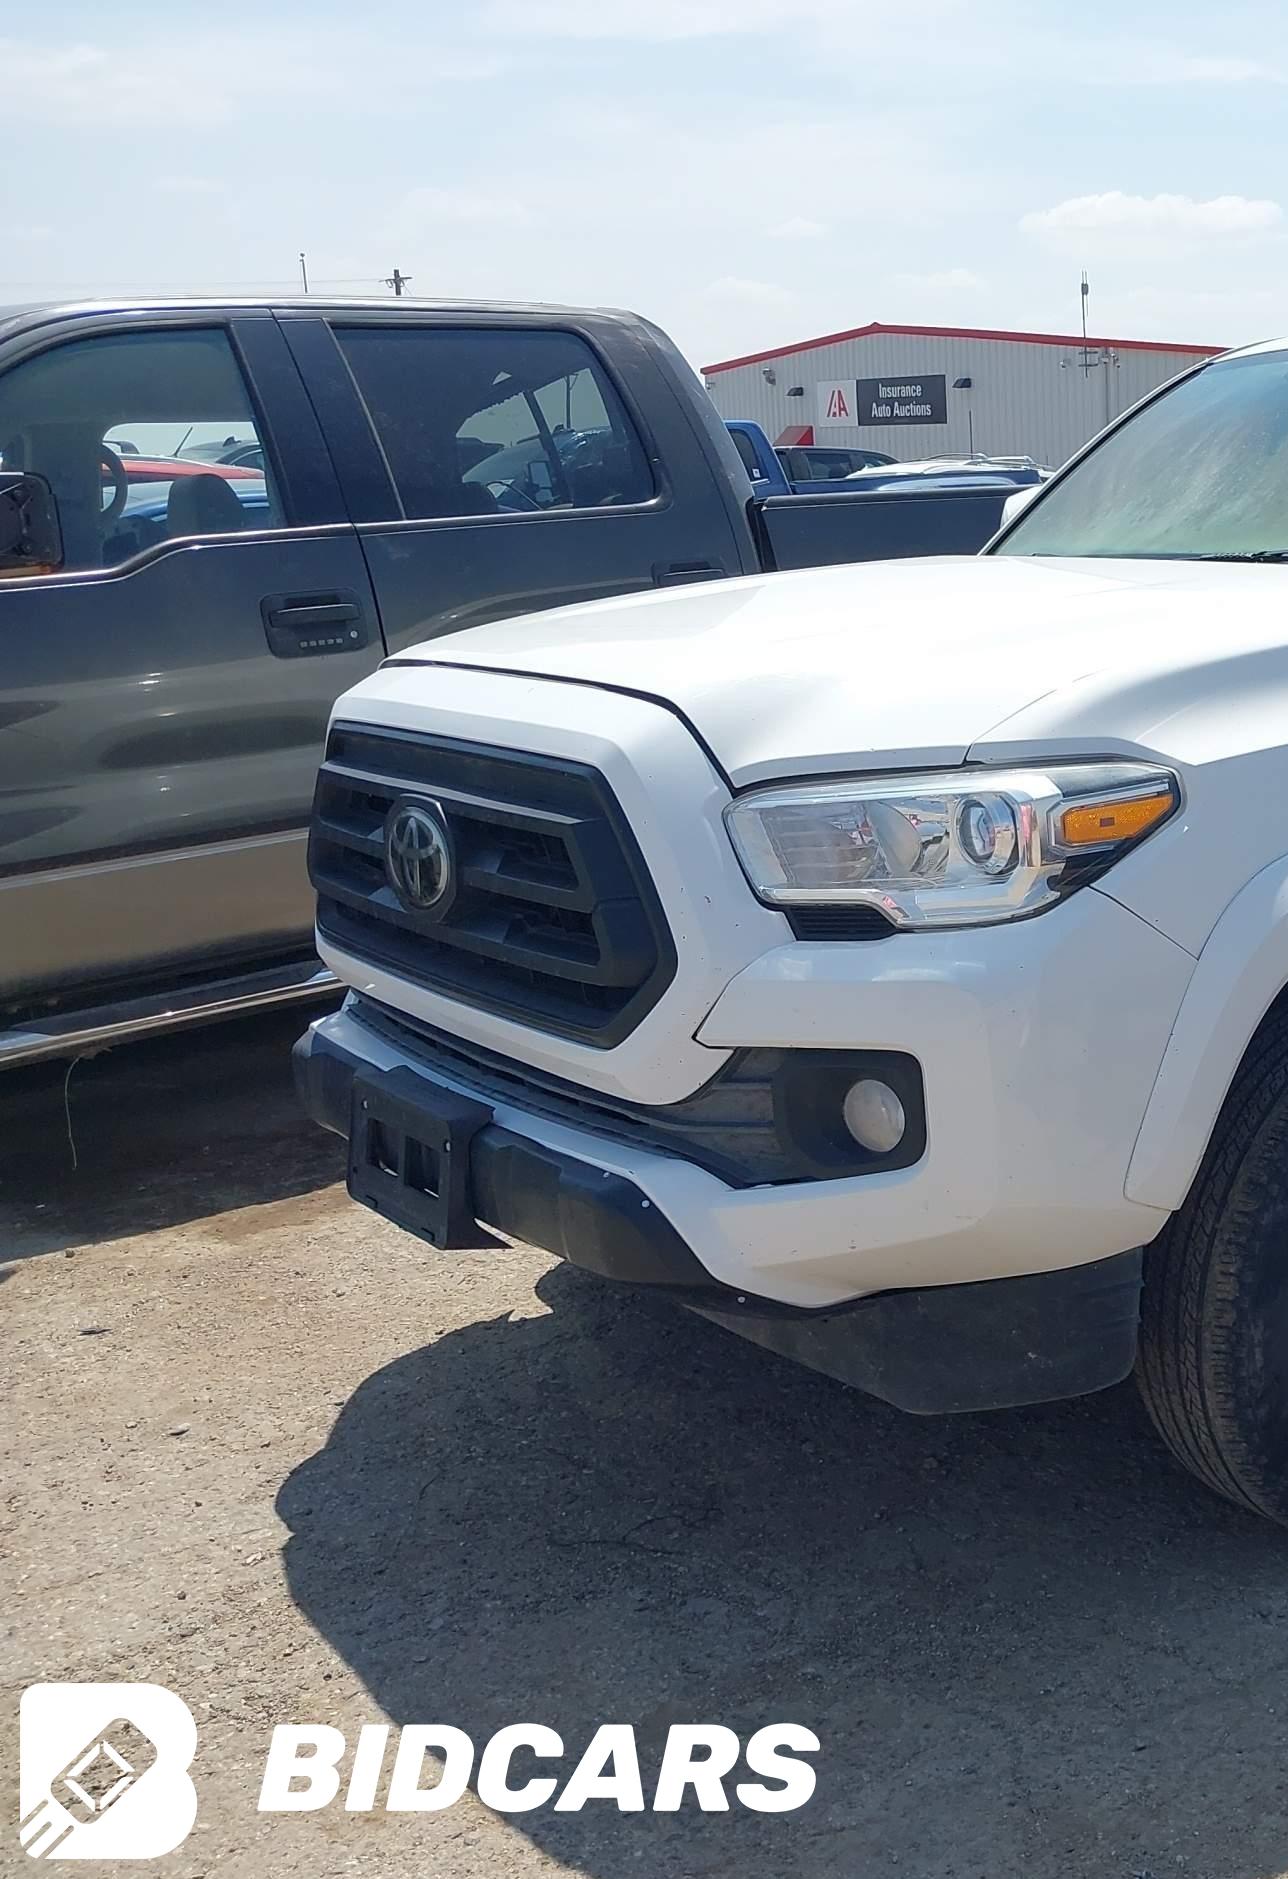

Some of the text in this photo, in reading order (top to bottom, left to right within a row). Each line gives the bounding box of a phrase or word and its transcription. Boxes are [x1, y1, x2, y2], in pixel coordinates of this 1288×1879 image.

[878, 384, 922, 399] Insurance
[871, 400, 932, 418] Auto Auctions
